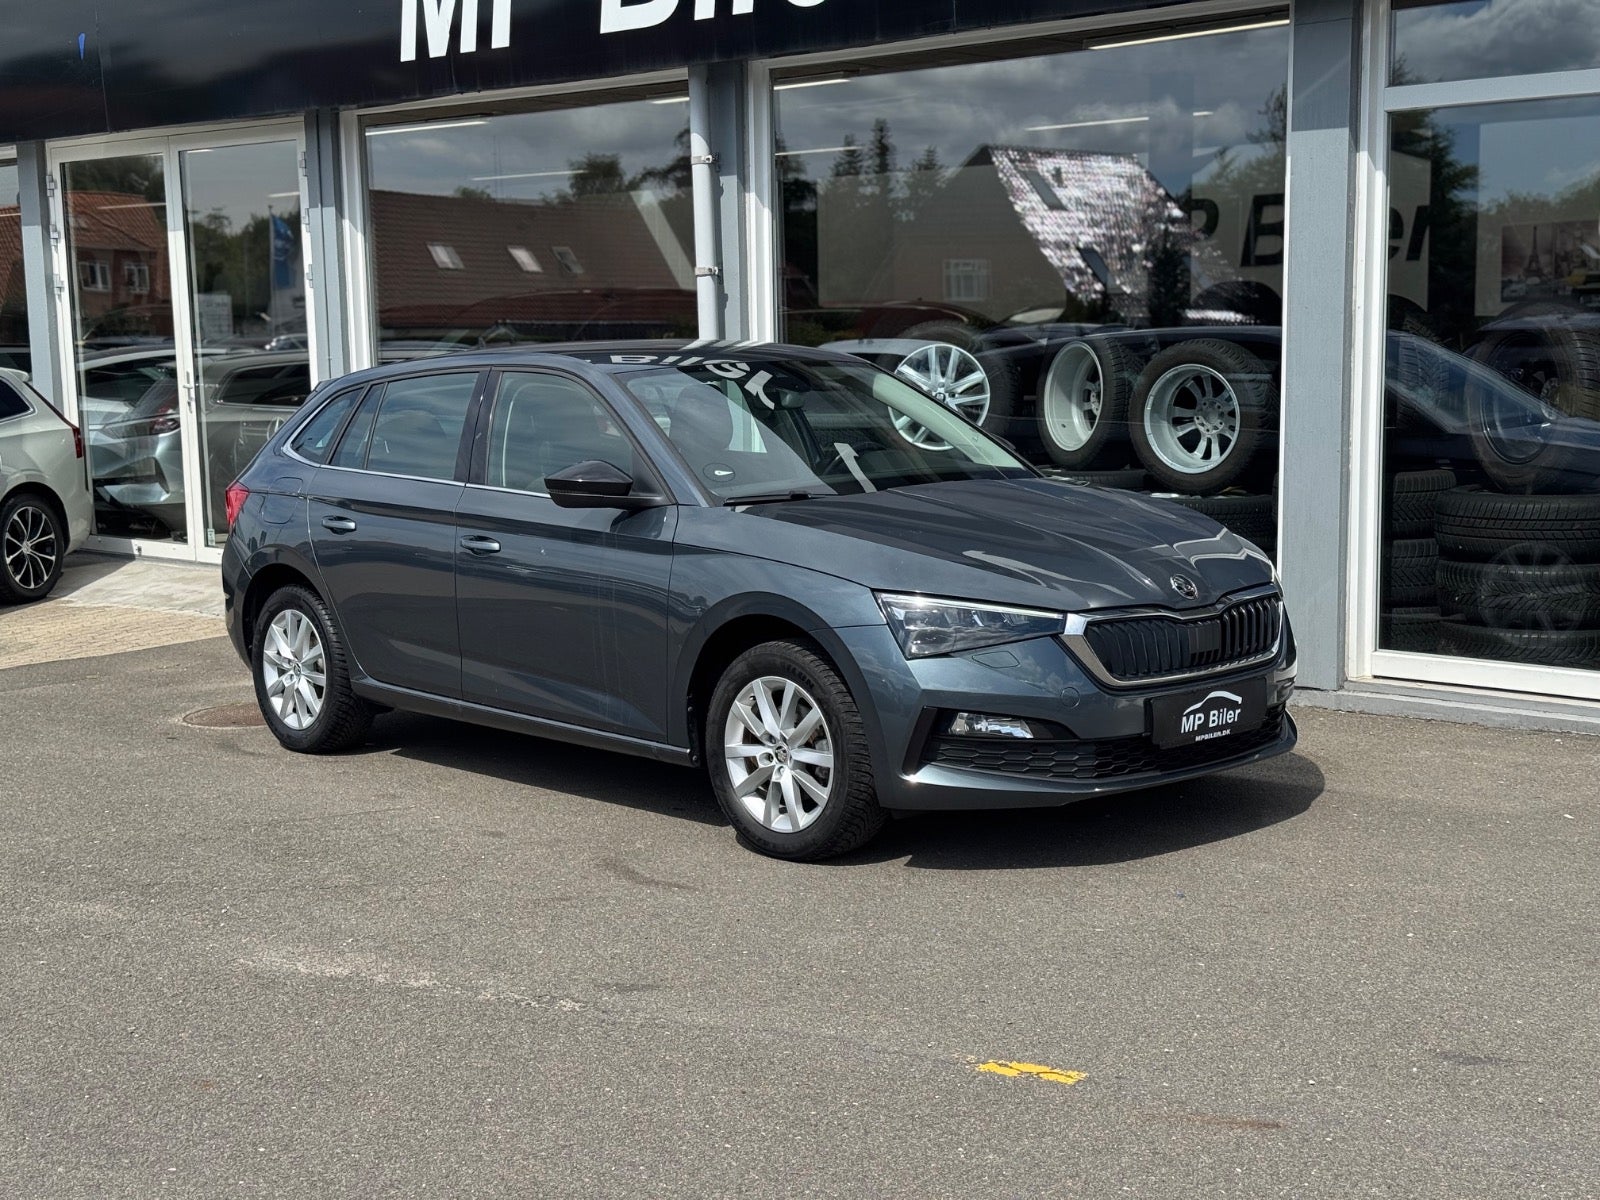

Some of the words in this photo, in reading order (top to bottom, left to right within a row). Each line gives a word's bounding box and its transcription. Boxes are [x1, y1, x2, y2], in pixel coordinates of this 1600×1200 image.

[1181, 713, 1205, 734] MP
[1209, 708, 1241, 727] Biler
[1195, 729, 1231, 741] MPBILER.DK
